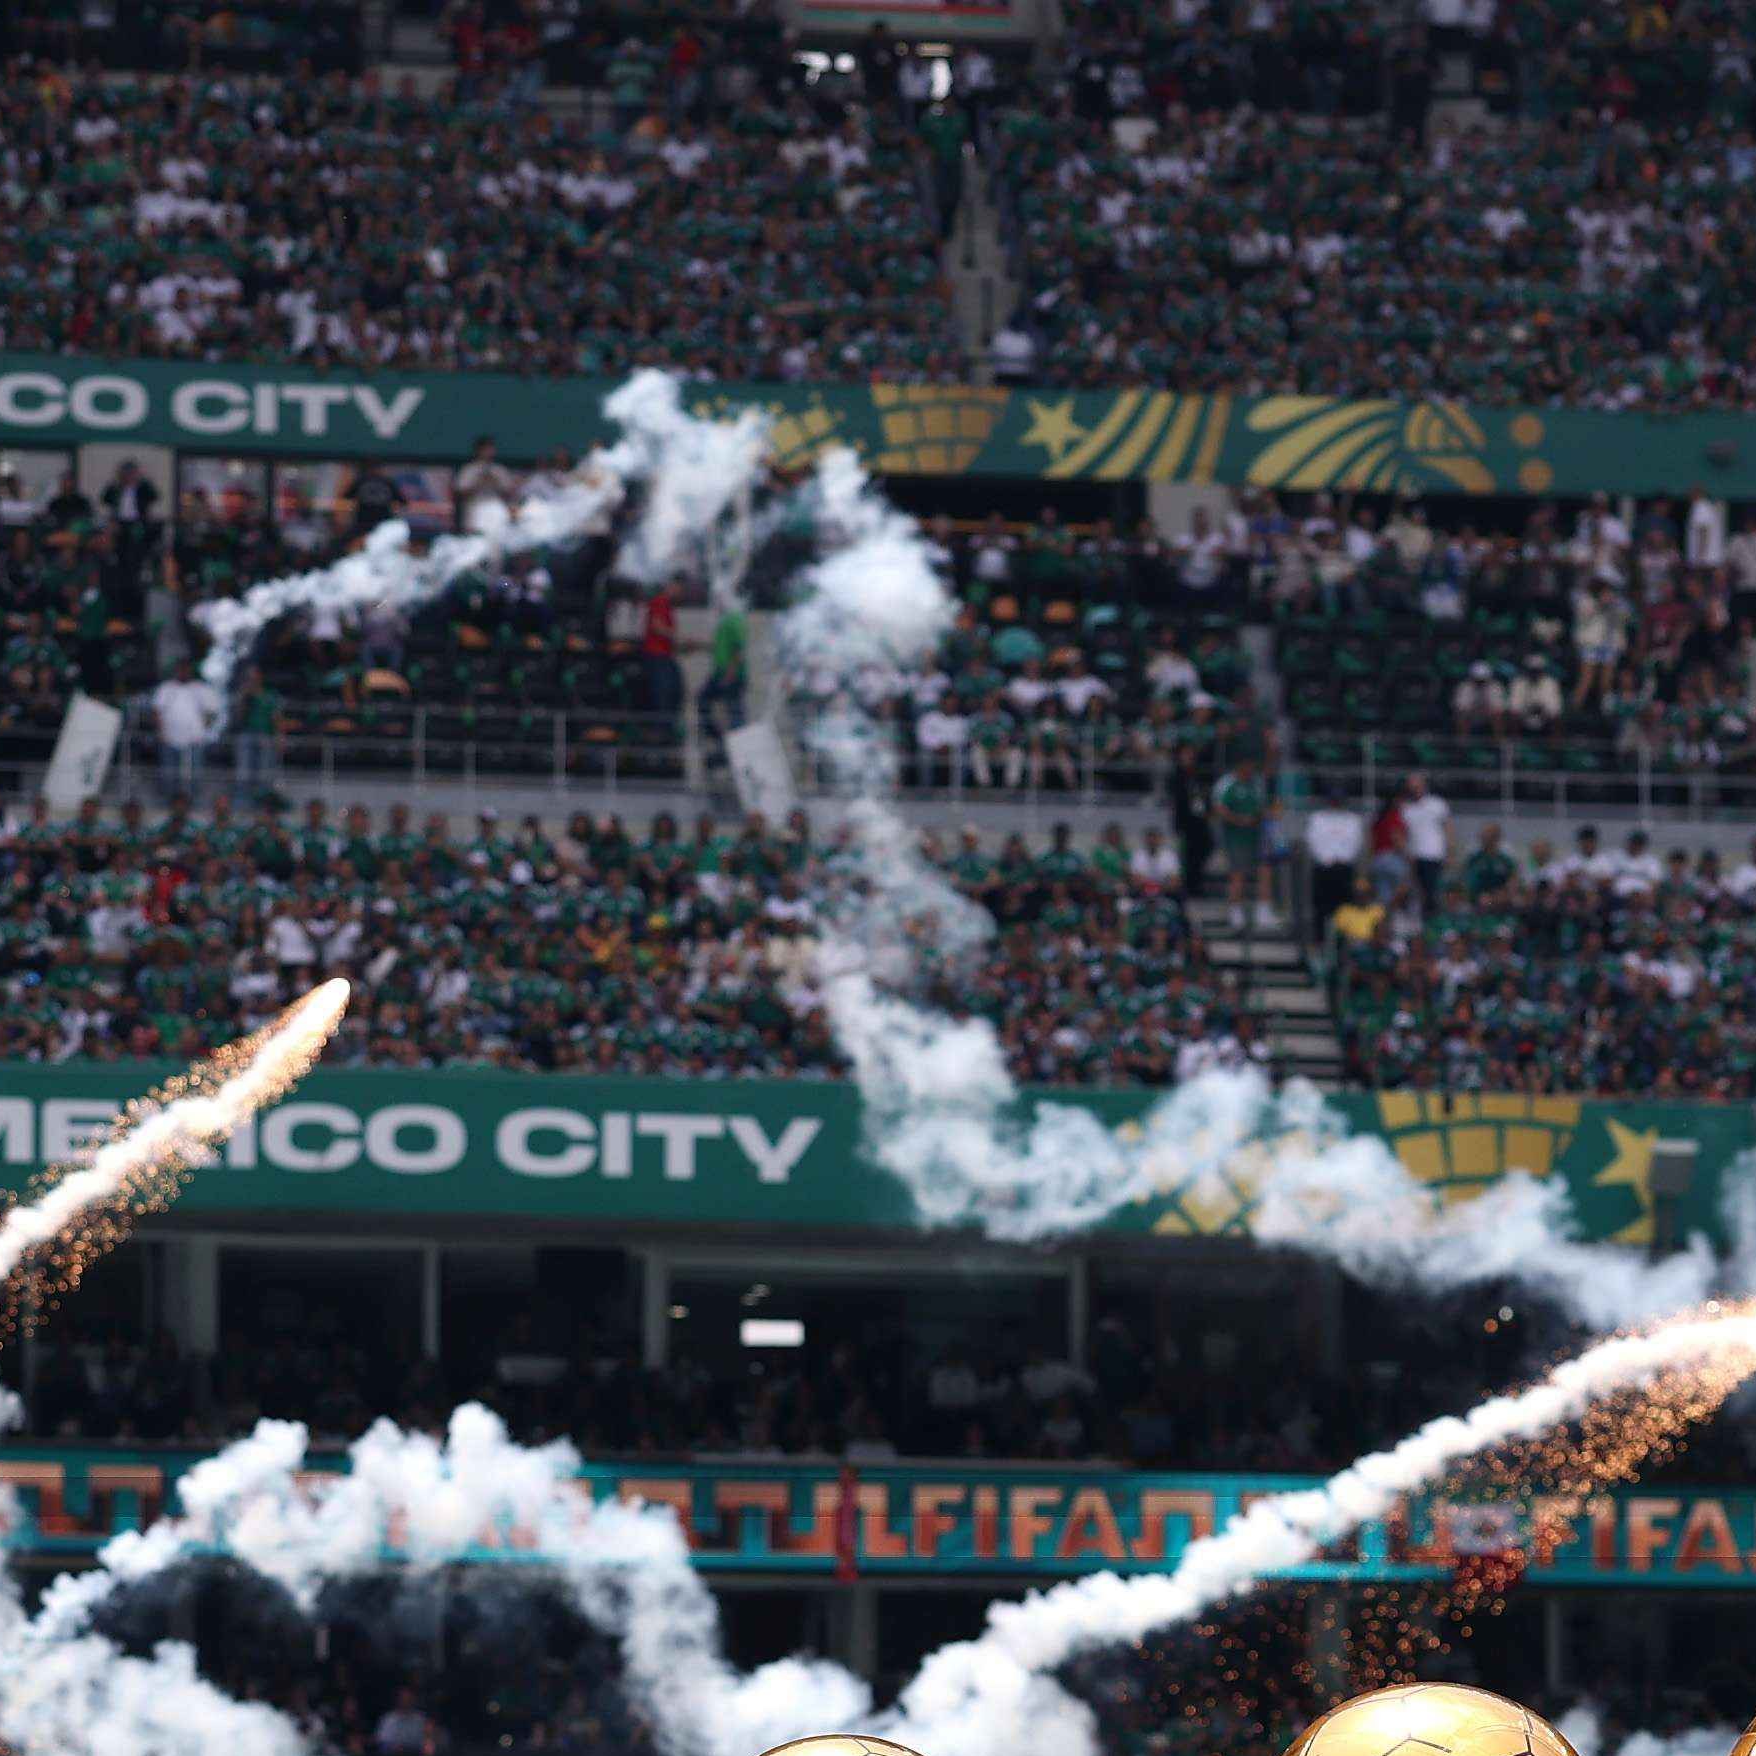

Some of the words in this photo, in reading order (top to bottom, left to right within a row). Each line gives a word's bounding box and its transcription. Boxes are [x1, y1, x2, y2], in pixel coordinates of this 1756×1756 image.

[171, 379, 426, 439] CITY
[493, 1112, 825, 1184] CITY
[912, 1484, 1127, 1560] FIFA
[1530, 1497, 1743, 1574] FIFA
